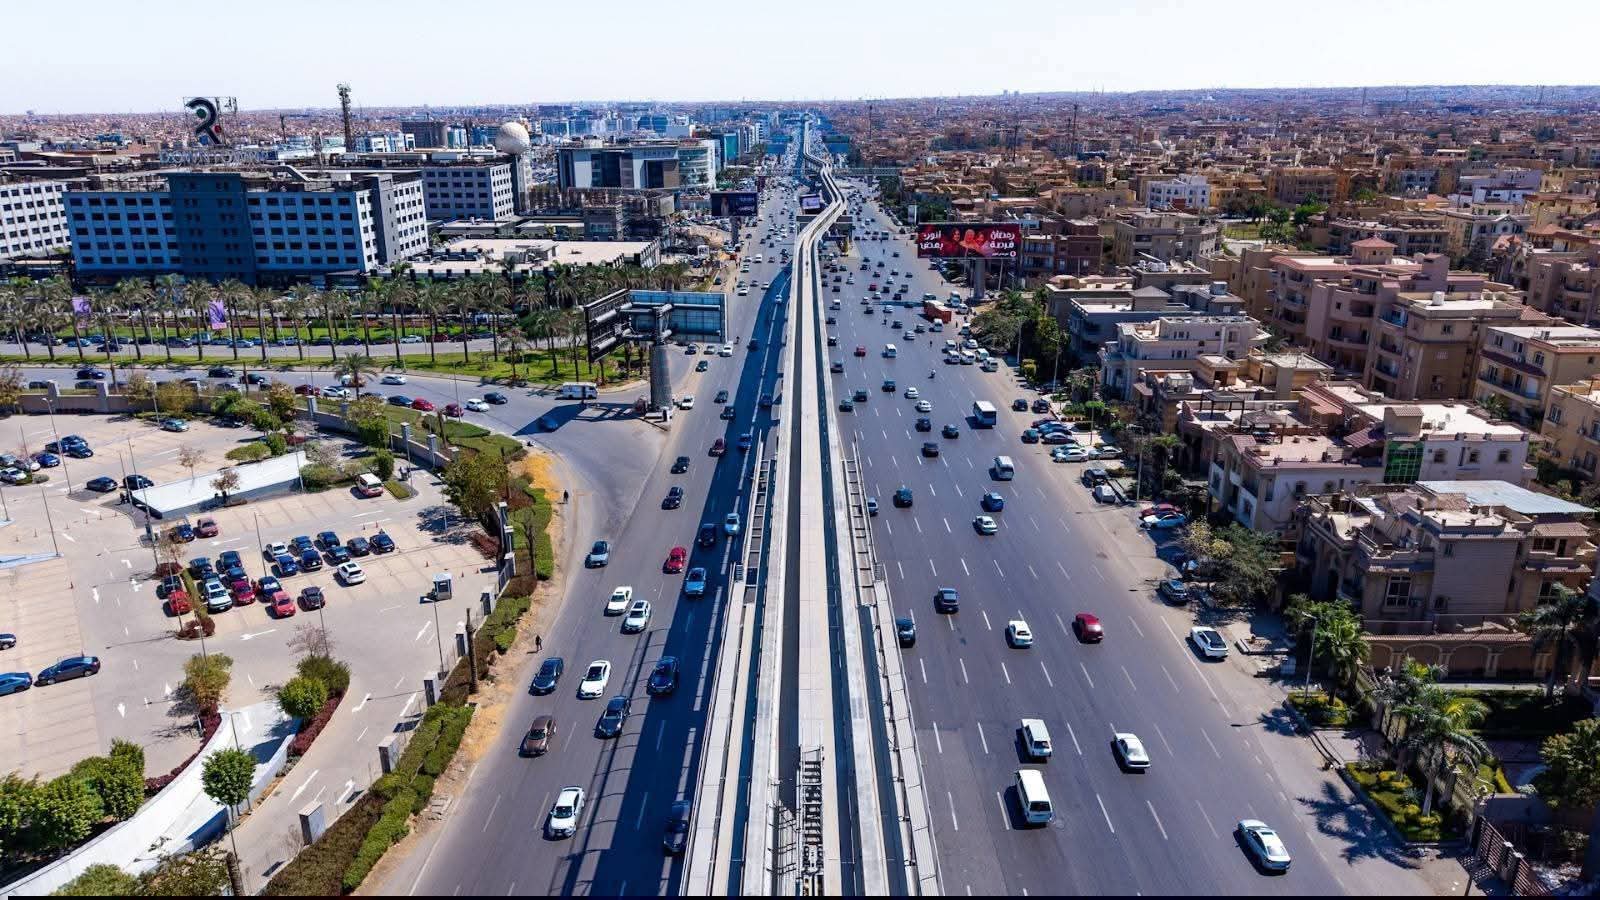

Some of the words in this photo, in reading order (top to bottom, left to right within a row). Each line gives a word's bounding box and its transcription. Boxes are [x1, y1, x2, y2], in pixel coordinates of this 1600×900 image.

[990, 230, 1015, 240] رمضان
[920, 241, 944, 250] بعض
[989, 240, 1014, 249] فرصة
